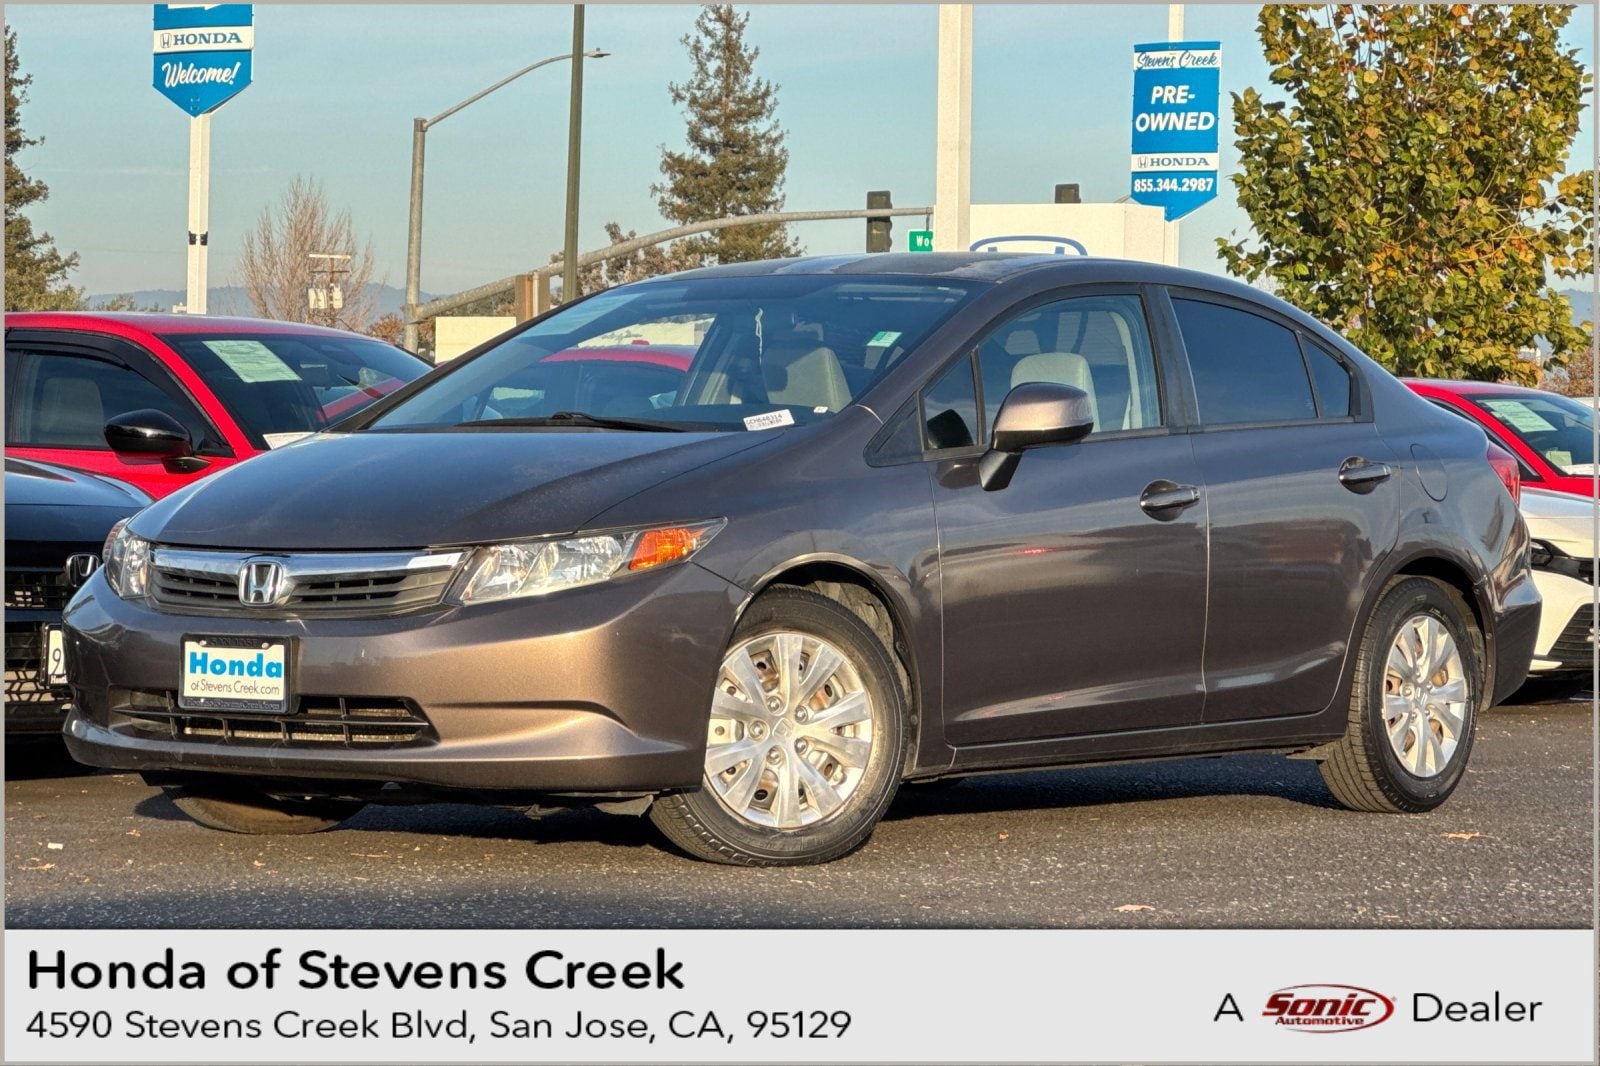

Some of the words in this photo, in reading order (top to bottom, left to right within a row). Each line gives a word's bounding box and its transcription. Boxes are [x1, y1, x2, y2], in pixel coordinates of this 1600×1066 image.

[173, 32, 243, 46] HONDA
[1136, 52, 1177, 70] Stevens
[1178, 50, 1217, 68] Creek
[161, 61, 241, 88] Welcome!
[1150, 85, 1196, 105] PRE-
[1135, 111, 1215, 132] OWNED
[1150, 157, 1210, 167] HONDA
[1134, 177, 1214, 193] 855.344.2987
[189, 651, 283, 678] Honda
[190, 680, 201, 691] of
[200, 679, 232, 693] Stevens
[233, 680, 280, 695] Creek.com
